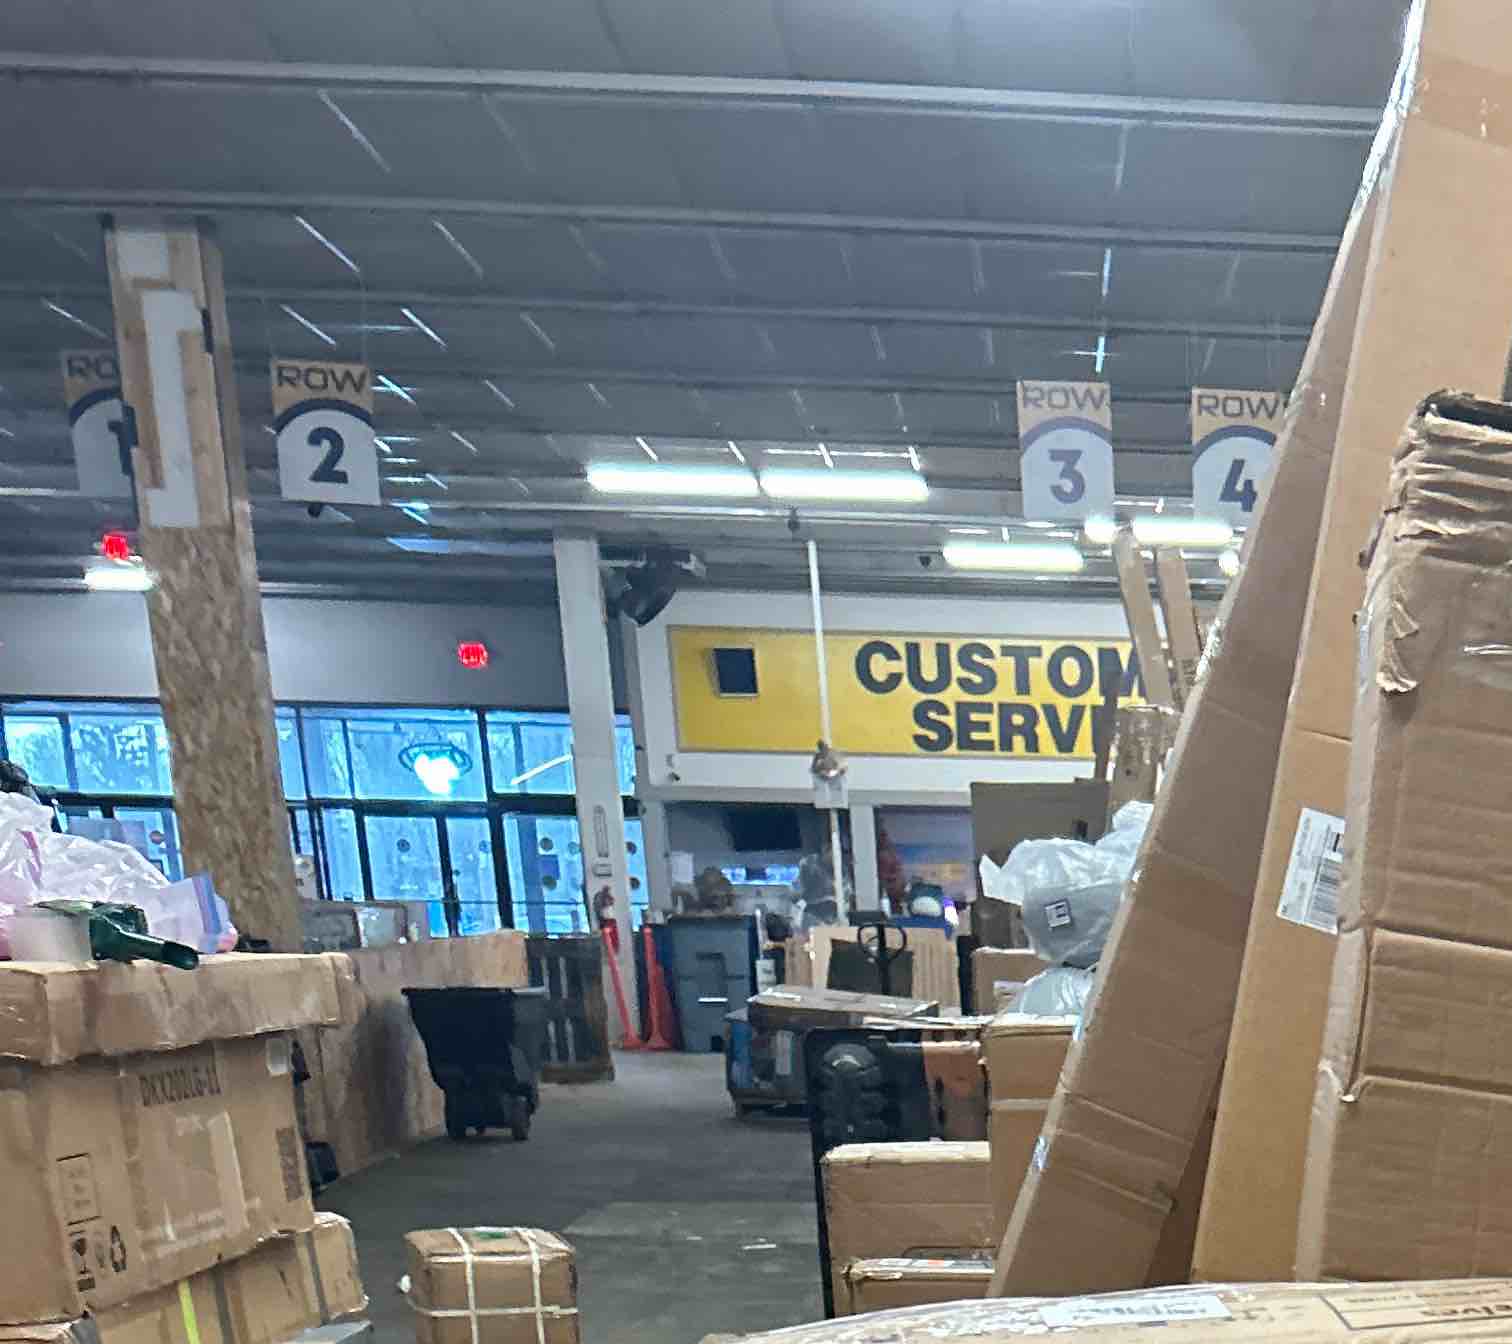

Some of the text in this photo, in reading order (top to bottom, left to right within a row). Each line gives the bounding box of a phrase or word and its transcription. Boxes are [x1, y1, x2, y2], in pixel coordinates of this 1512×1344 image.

[66, 355, 120, 380] RO
[276, 364, 367, 393] ROW
[1022, 385, 1107, 411] ROW
[1199, 393, 1279, 420] ROW
[307, 427, 348, 484] 2
[1048, 449, 1086, 504] 3
[1219, 458, 1258, 512] 4
